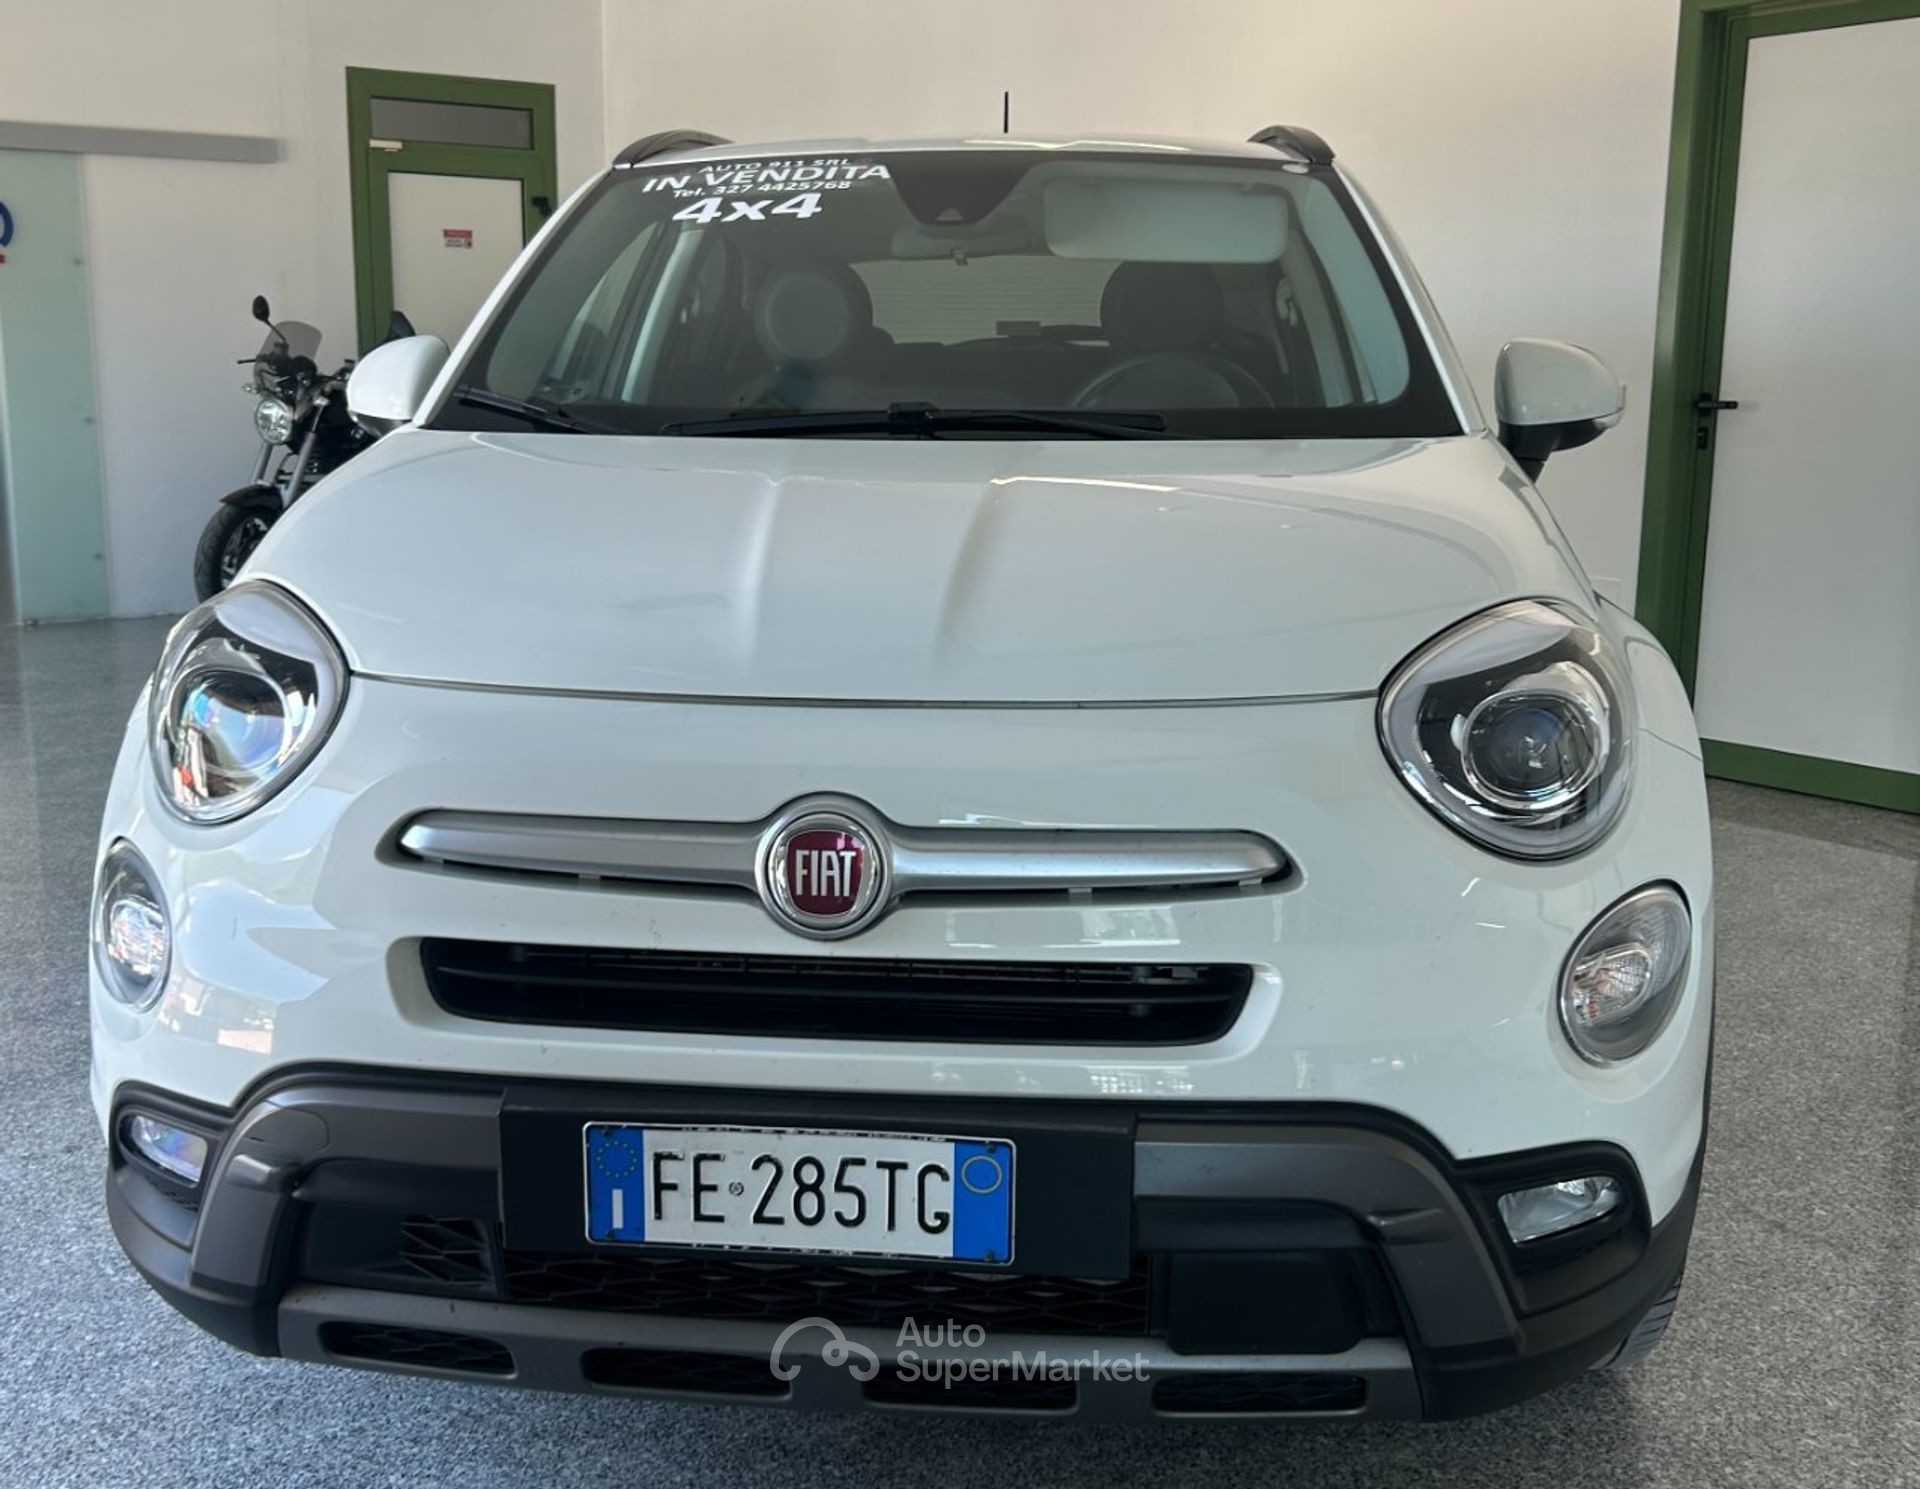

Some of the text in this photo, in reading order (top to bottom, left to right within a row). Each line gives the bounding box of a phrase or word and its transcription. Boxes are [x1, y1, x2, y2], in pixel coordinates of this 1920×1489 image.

[642, 164, 891, 192] IN VENDITA
[698, 162, 762, 173] AUTO
[813, 158, 850, 166] SRL
[673, 181, 852, 198] Tel. 327 4425768
[672, 193, 822, 224] 4x4
[796, 850, 856, 897] FIAT
[653, 1151, 726, 1223] FE
[751, 1153, 950, 1235] 285TG
